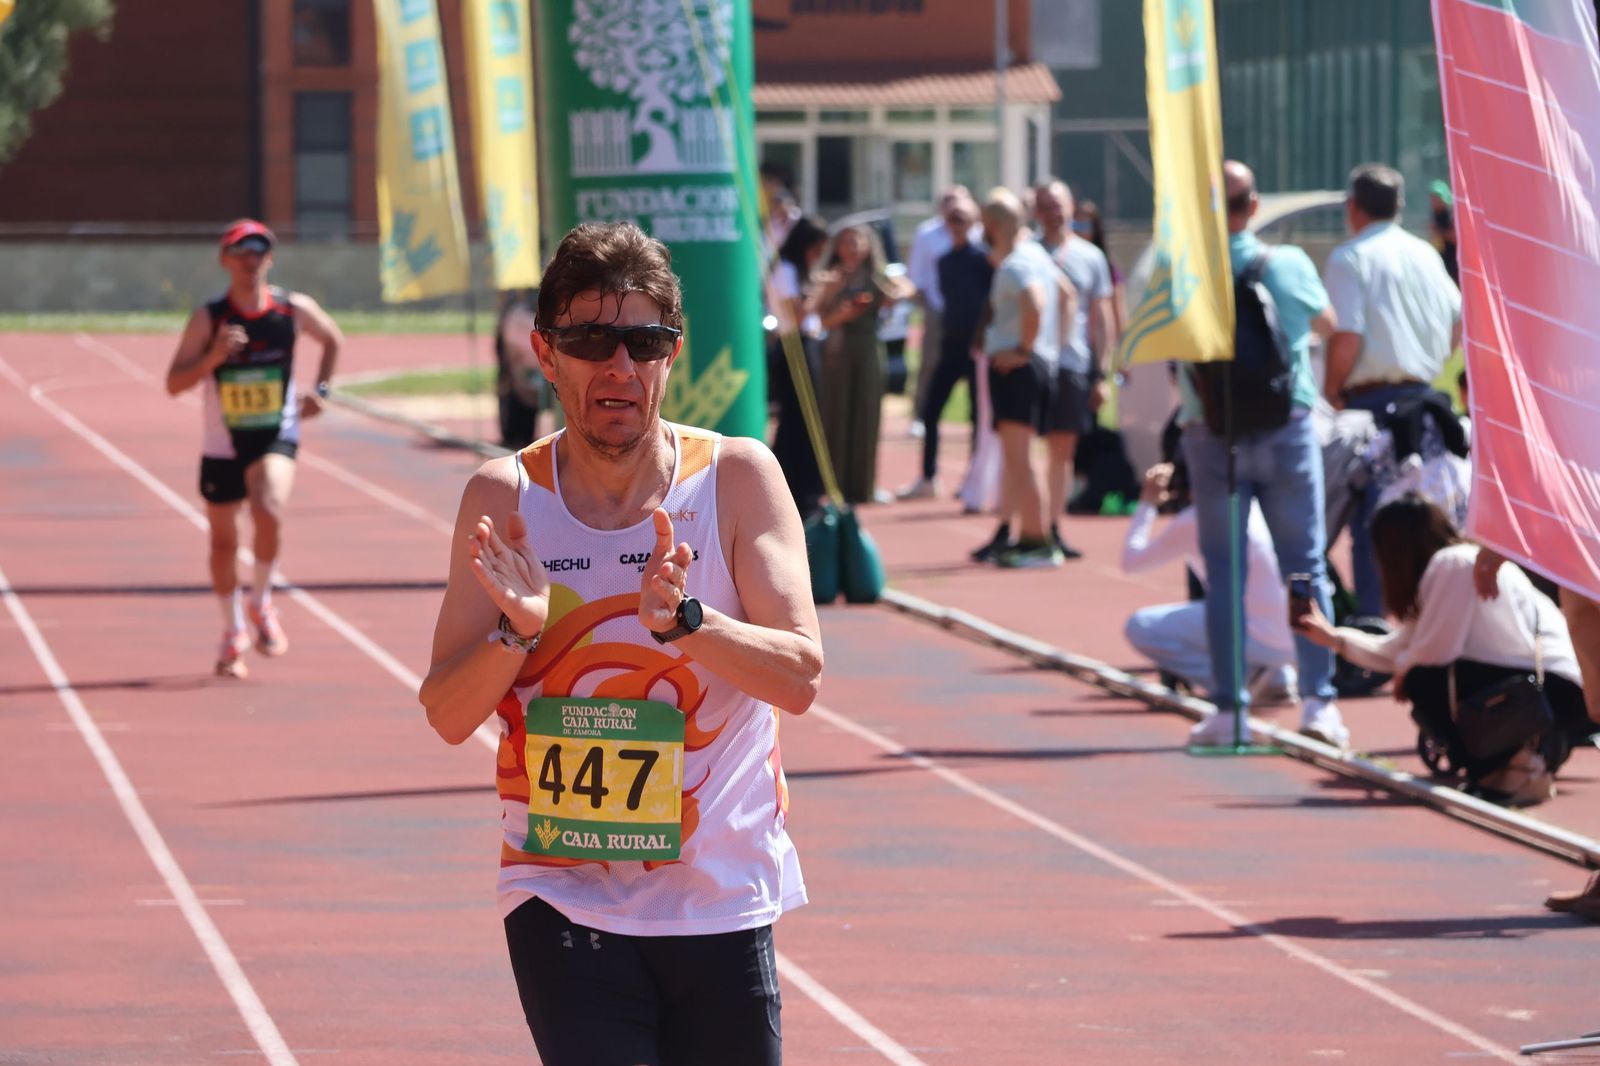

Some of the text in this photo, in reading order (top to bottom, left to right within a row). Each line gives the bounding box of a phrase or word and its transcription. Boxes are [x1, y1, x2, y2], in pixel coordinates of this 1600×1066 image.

[230, 387, 270, 410] 113
[540, 558, 590, 571] HECHU
[562, 716, 637, 730] CAJA RURAL
[573, 729, 602, 737] ZAMORA
[538, 743, 660, 811] 447
[561, 830, 672, 850] CAJA RURAL
